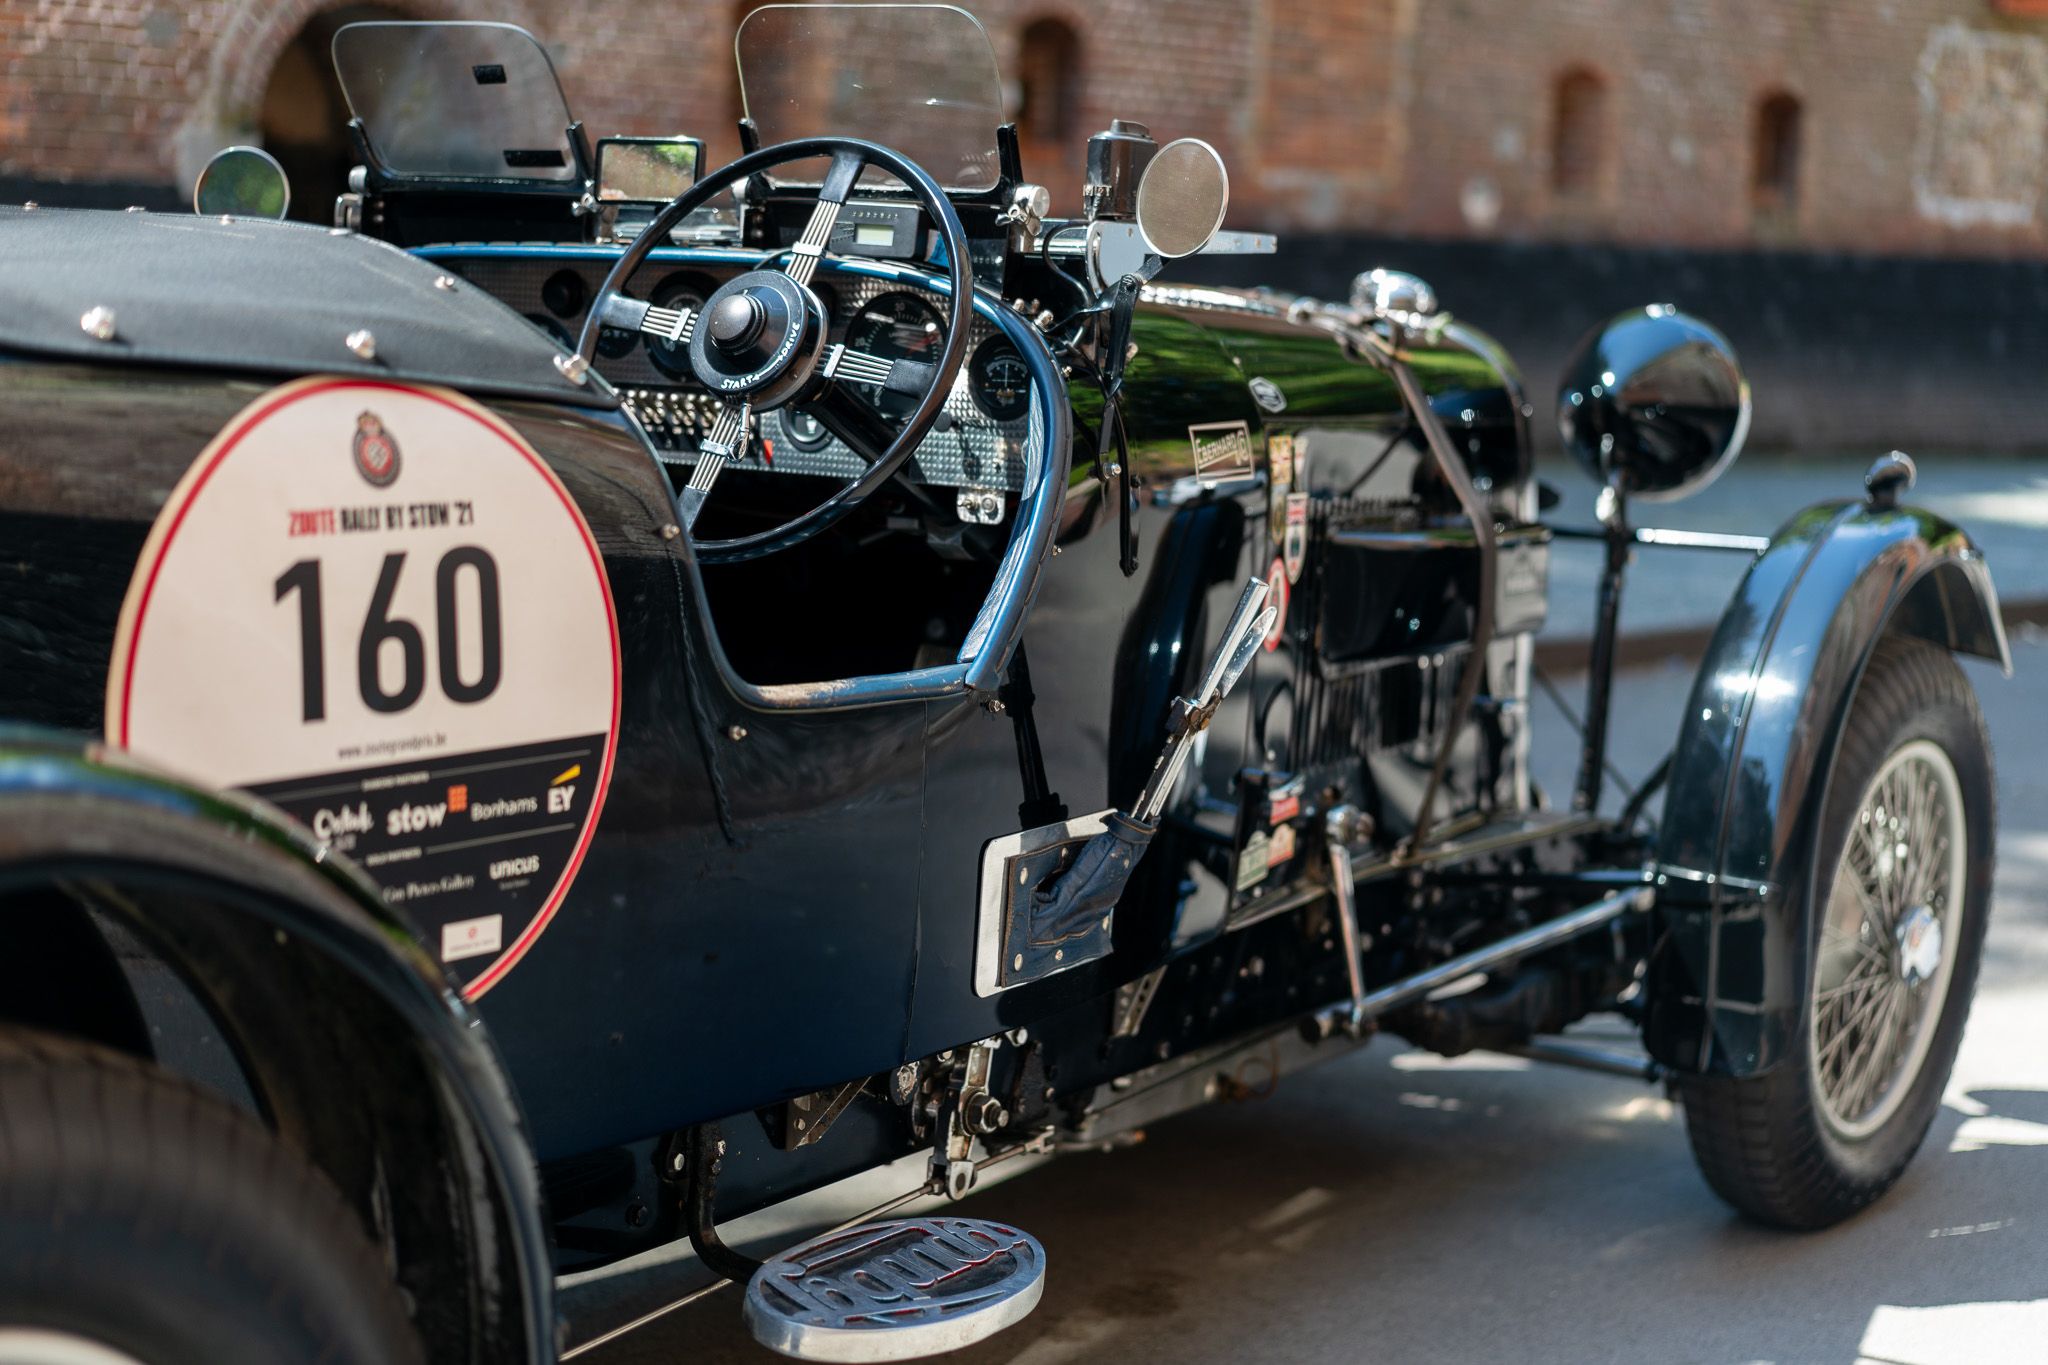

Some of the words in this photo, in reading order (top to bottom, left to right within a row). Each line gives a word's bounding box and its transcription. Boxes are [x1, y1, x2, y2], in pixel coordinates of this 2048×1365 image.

[721, 377, 753, 390] START
[780, 322, 800, 356] DRIVE
[1196, 433, 1237, 464] EBERHARD
[288, 508, 336, 538] ZOUTE
[341, 505, 380, 533] RALLY
[386, 504, 404, 531] BY
[409, 501, 449, 529] STOW
[274, 545, 502, 724] 160
[387, 803, 447, 835] stow
[471, 796, 538, 822] Bonhams
[548, 785, 576, 813] EY
[490, 855, 540, 880] unicus
